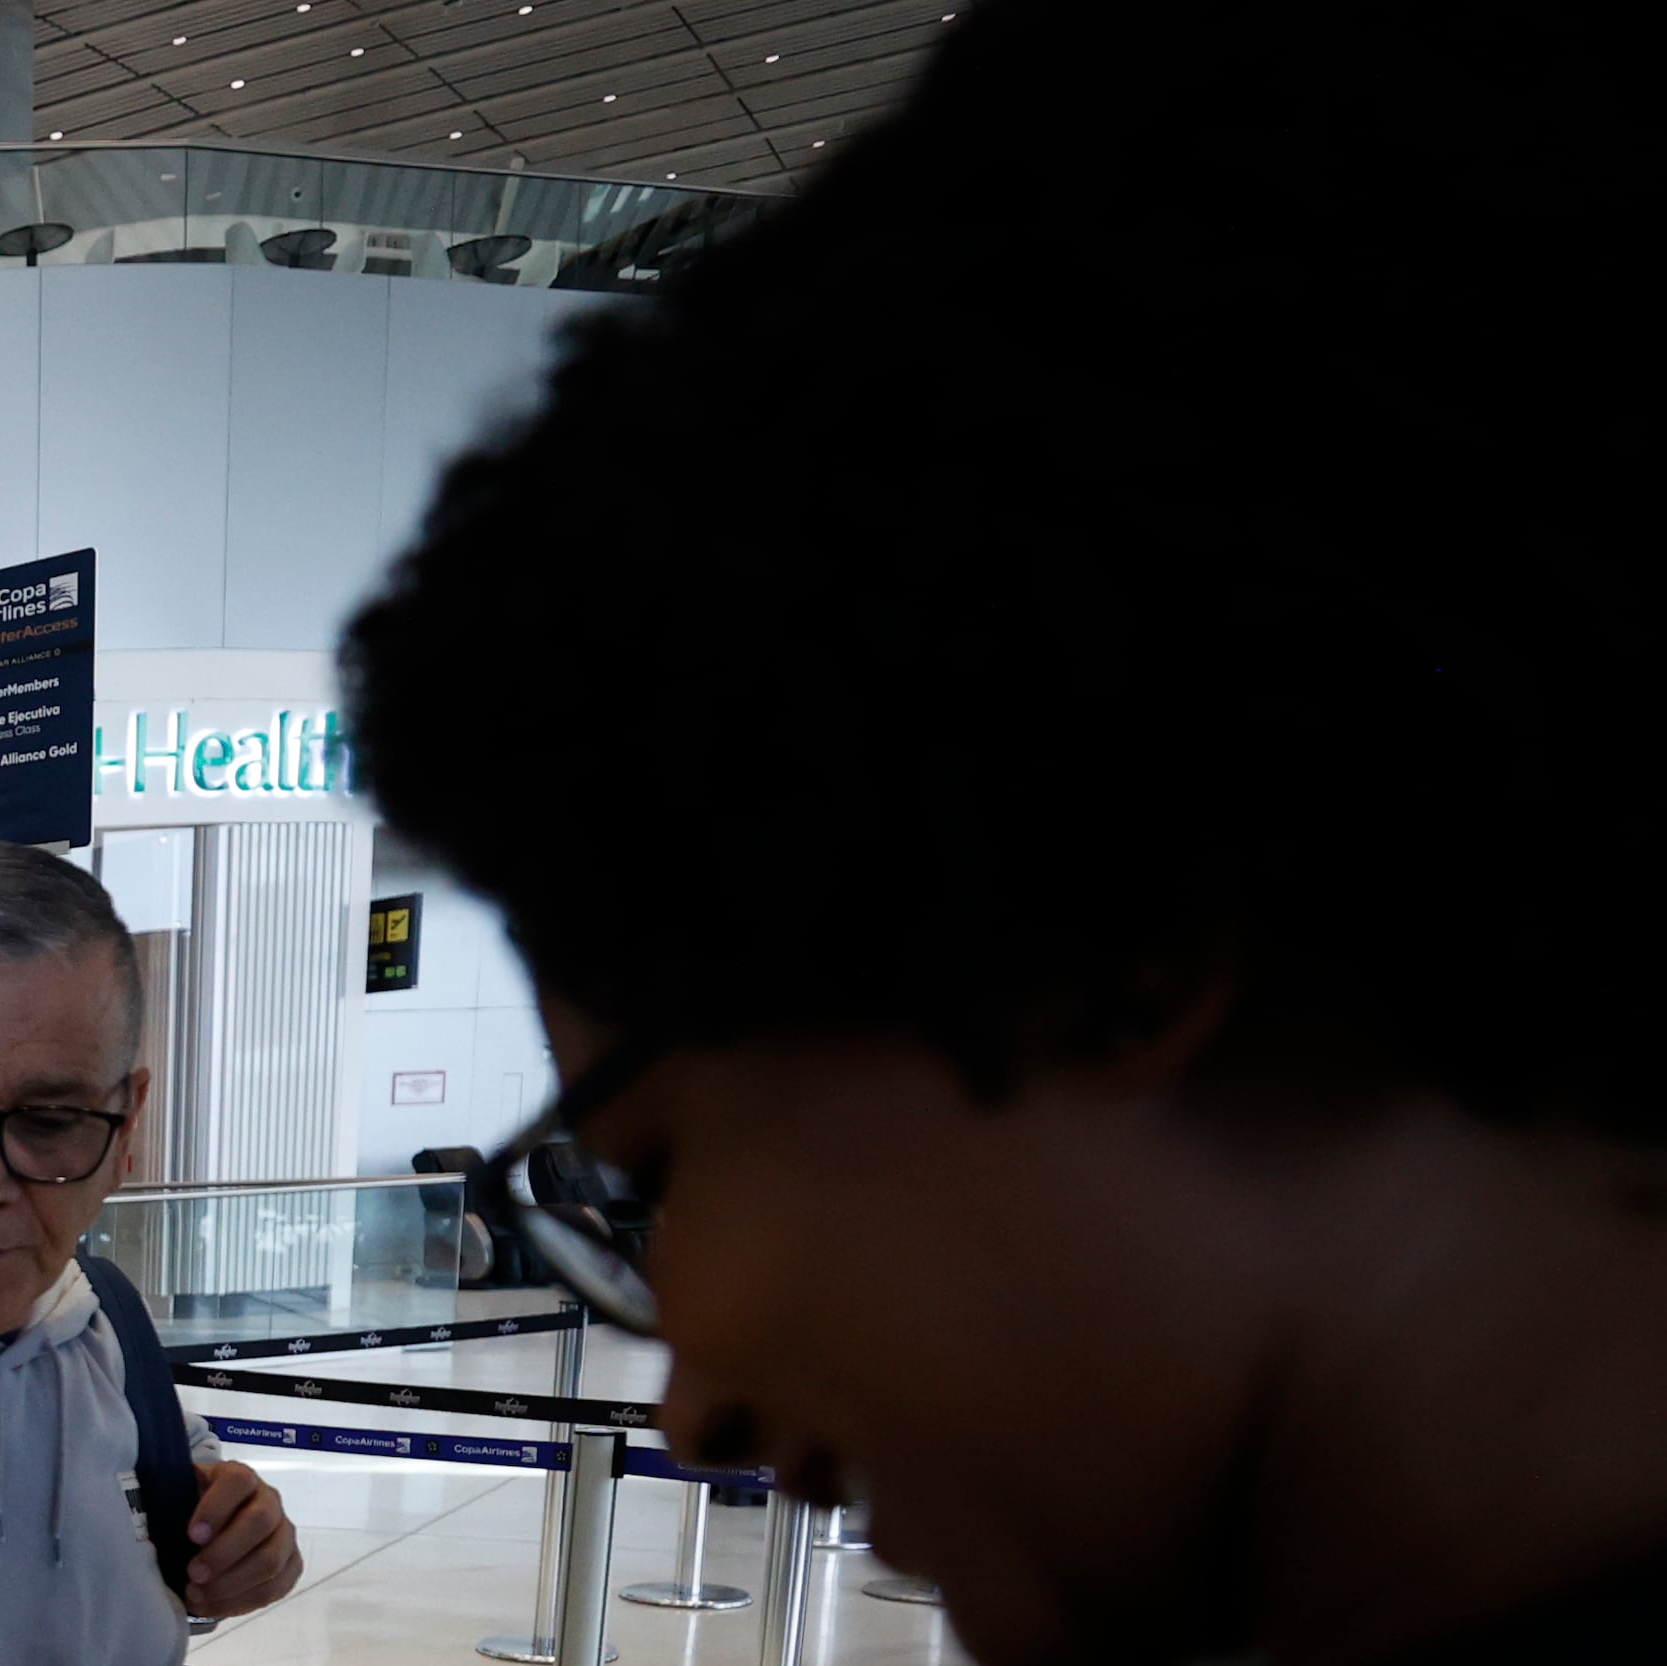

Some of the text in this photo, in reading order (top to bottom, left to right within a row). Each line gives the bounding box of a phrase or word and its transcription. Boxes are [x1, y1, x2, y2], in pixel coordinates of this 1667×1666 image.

[11, 650, 52, 666] ALLIANCE
[8, 704, 61, 725] Ejecutiva
[15, 723, 41, 736] Class
[0, 750, 47, 766] Alliance
[49, 742, 78, 758] Gold
[454, 1444, 521, 1458] CopaAirlines
